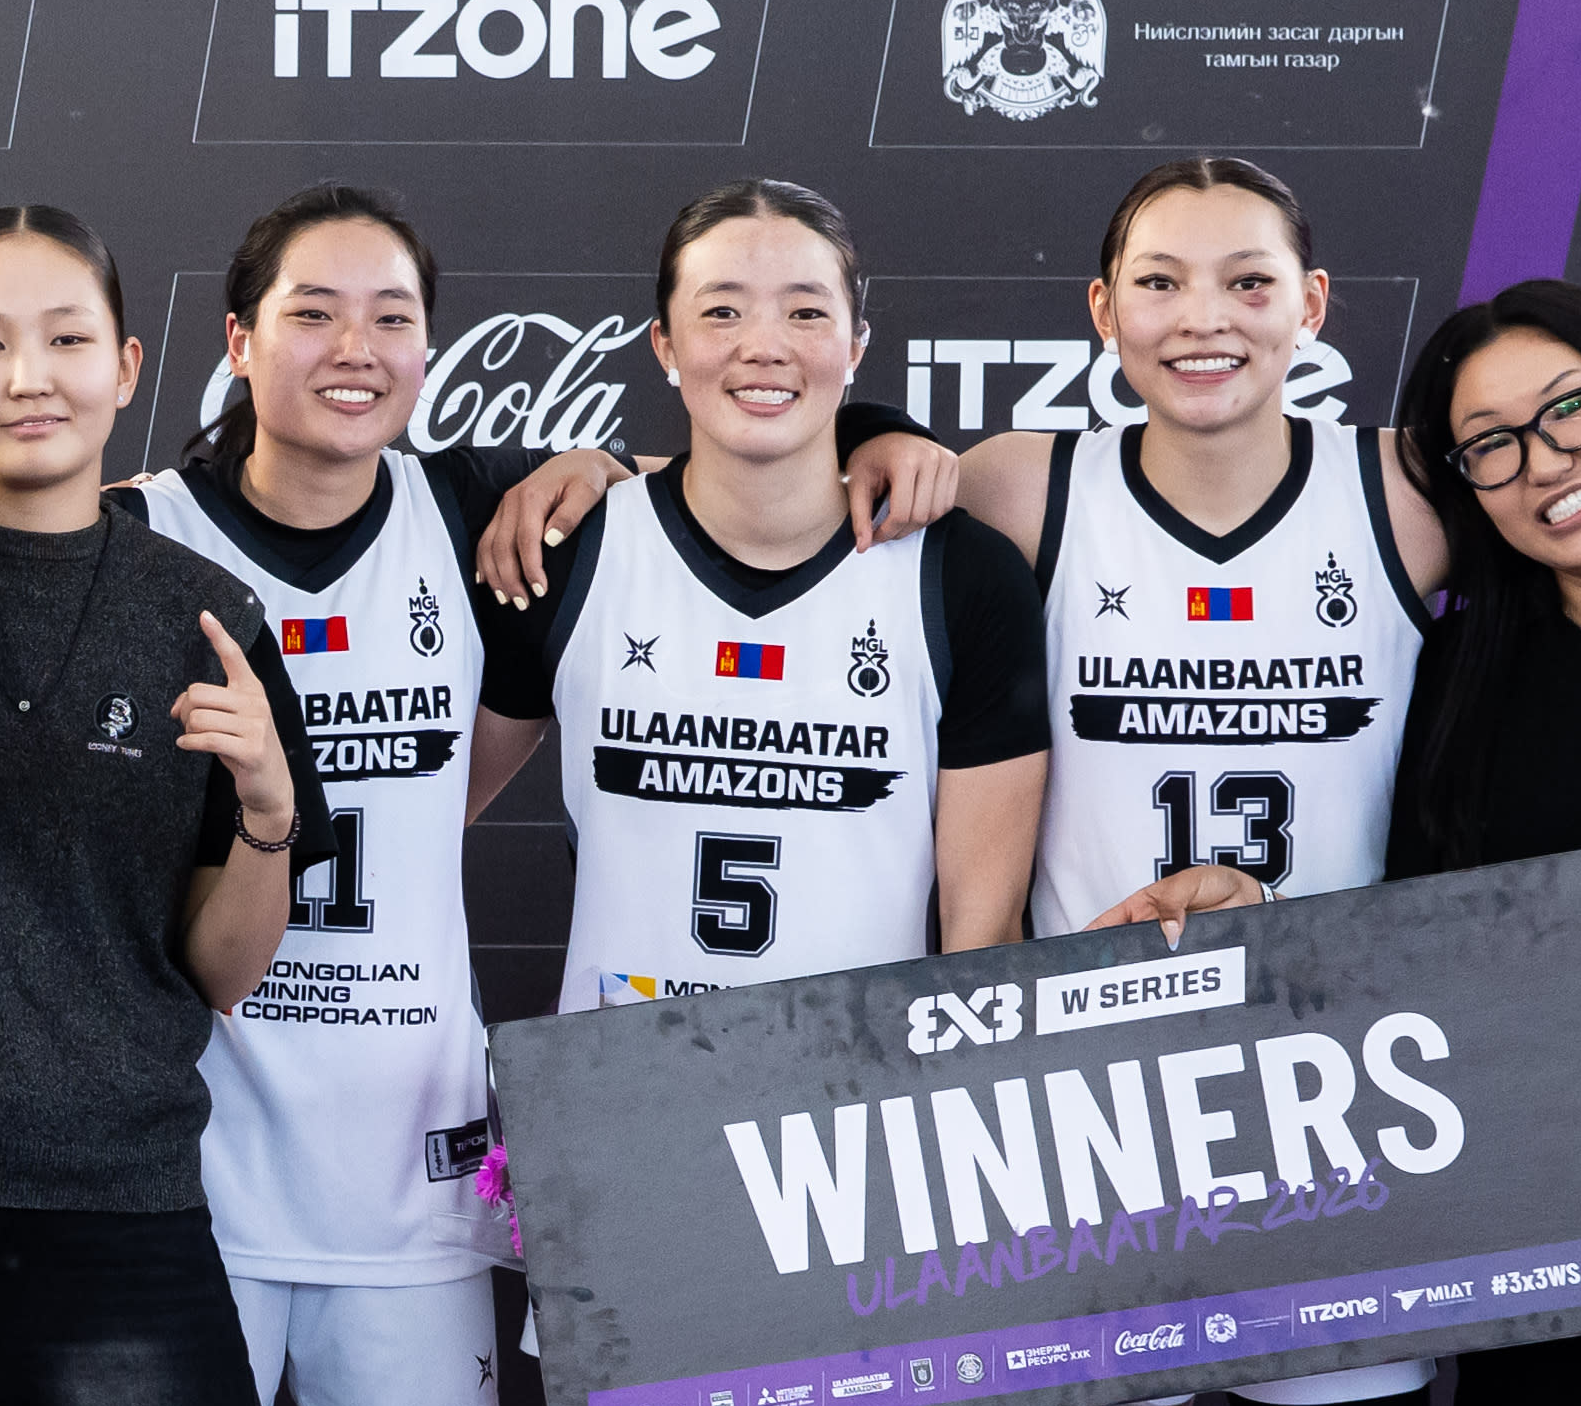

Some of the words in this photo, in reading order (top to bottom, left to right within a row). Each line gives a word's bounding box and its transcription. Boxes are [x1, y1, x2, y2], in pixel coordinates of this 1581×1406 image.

[1134, 21, 1261, 41] Нийслэлийн
[1267, 25, 1322, 41] засаг
[1328, 26, 1405, 45] даргын
[1204, 54, 1279, 68] тамгын
[1284, 54, 1340, 72] газар
[1315, 568, 1352, 586] MGL
[851, 636, 886, 653] MGL
[1077, 654, 1365, 691] ULAANBAATAR
[300, 685, 452, 727] BAATAR
[1118, 701, 1327, 737] AMAZONS
[600, 707, 889, 759] ULAANBAATAR
[638, 758, 844, 804] AMAZONS
[1152, 770, 1296, 889] 13
[691, 830, 782, 958] 5
[266, 960, 420, 982] ONGOLIAN
[1061, 985, 1093, 1016] W
[1099, 966, 1222, 1010] SERIES
[242, 1001, 437, 1026] CORPORATION
[723, 1011, 1466, 1275] WINNERS
[845, 1185, 1261, 1317] ULAANBAATAR
[1261, 1158, 1390, 1229] 2026
[1426, 1281, 1475, 1304] MIAT
[1490, 1262, 1581, 1296] #3x3WS
[1026, 1343, 1071, 1359] ЭНЕРЖИ
[1028, 1351, 1069, 1367] РЕСУРС
[843, 1382, 883, 1396] AMAZONS
